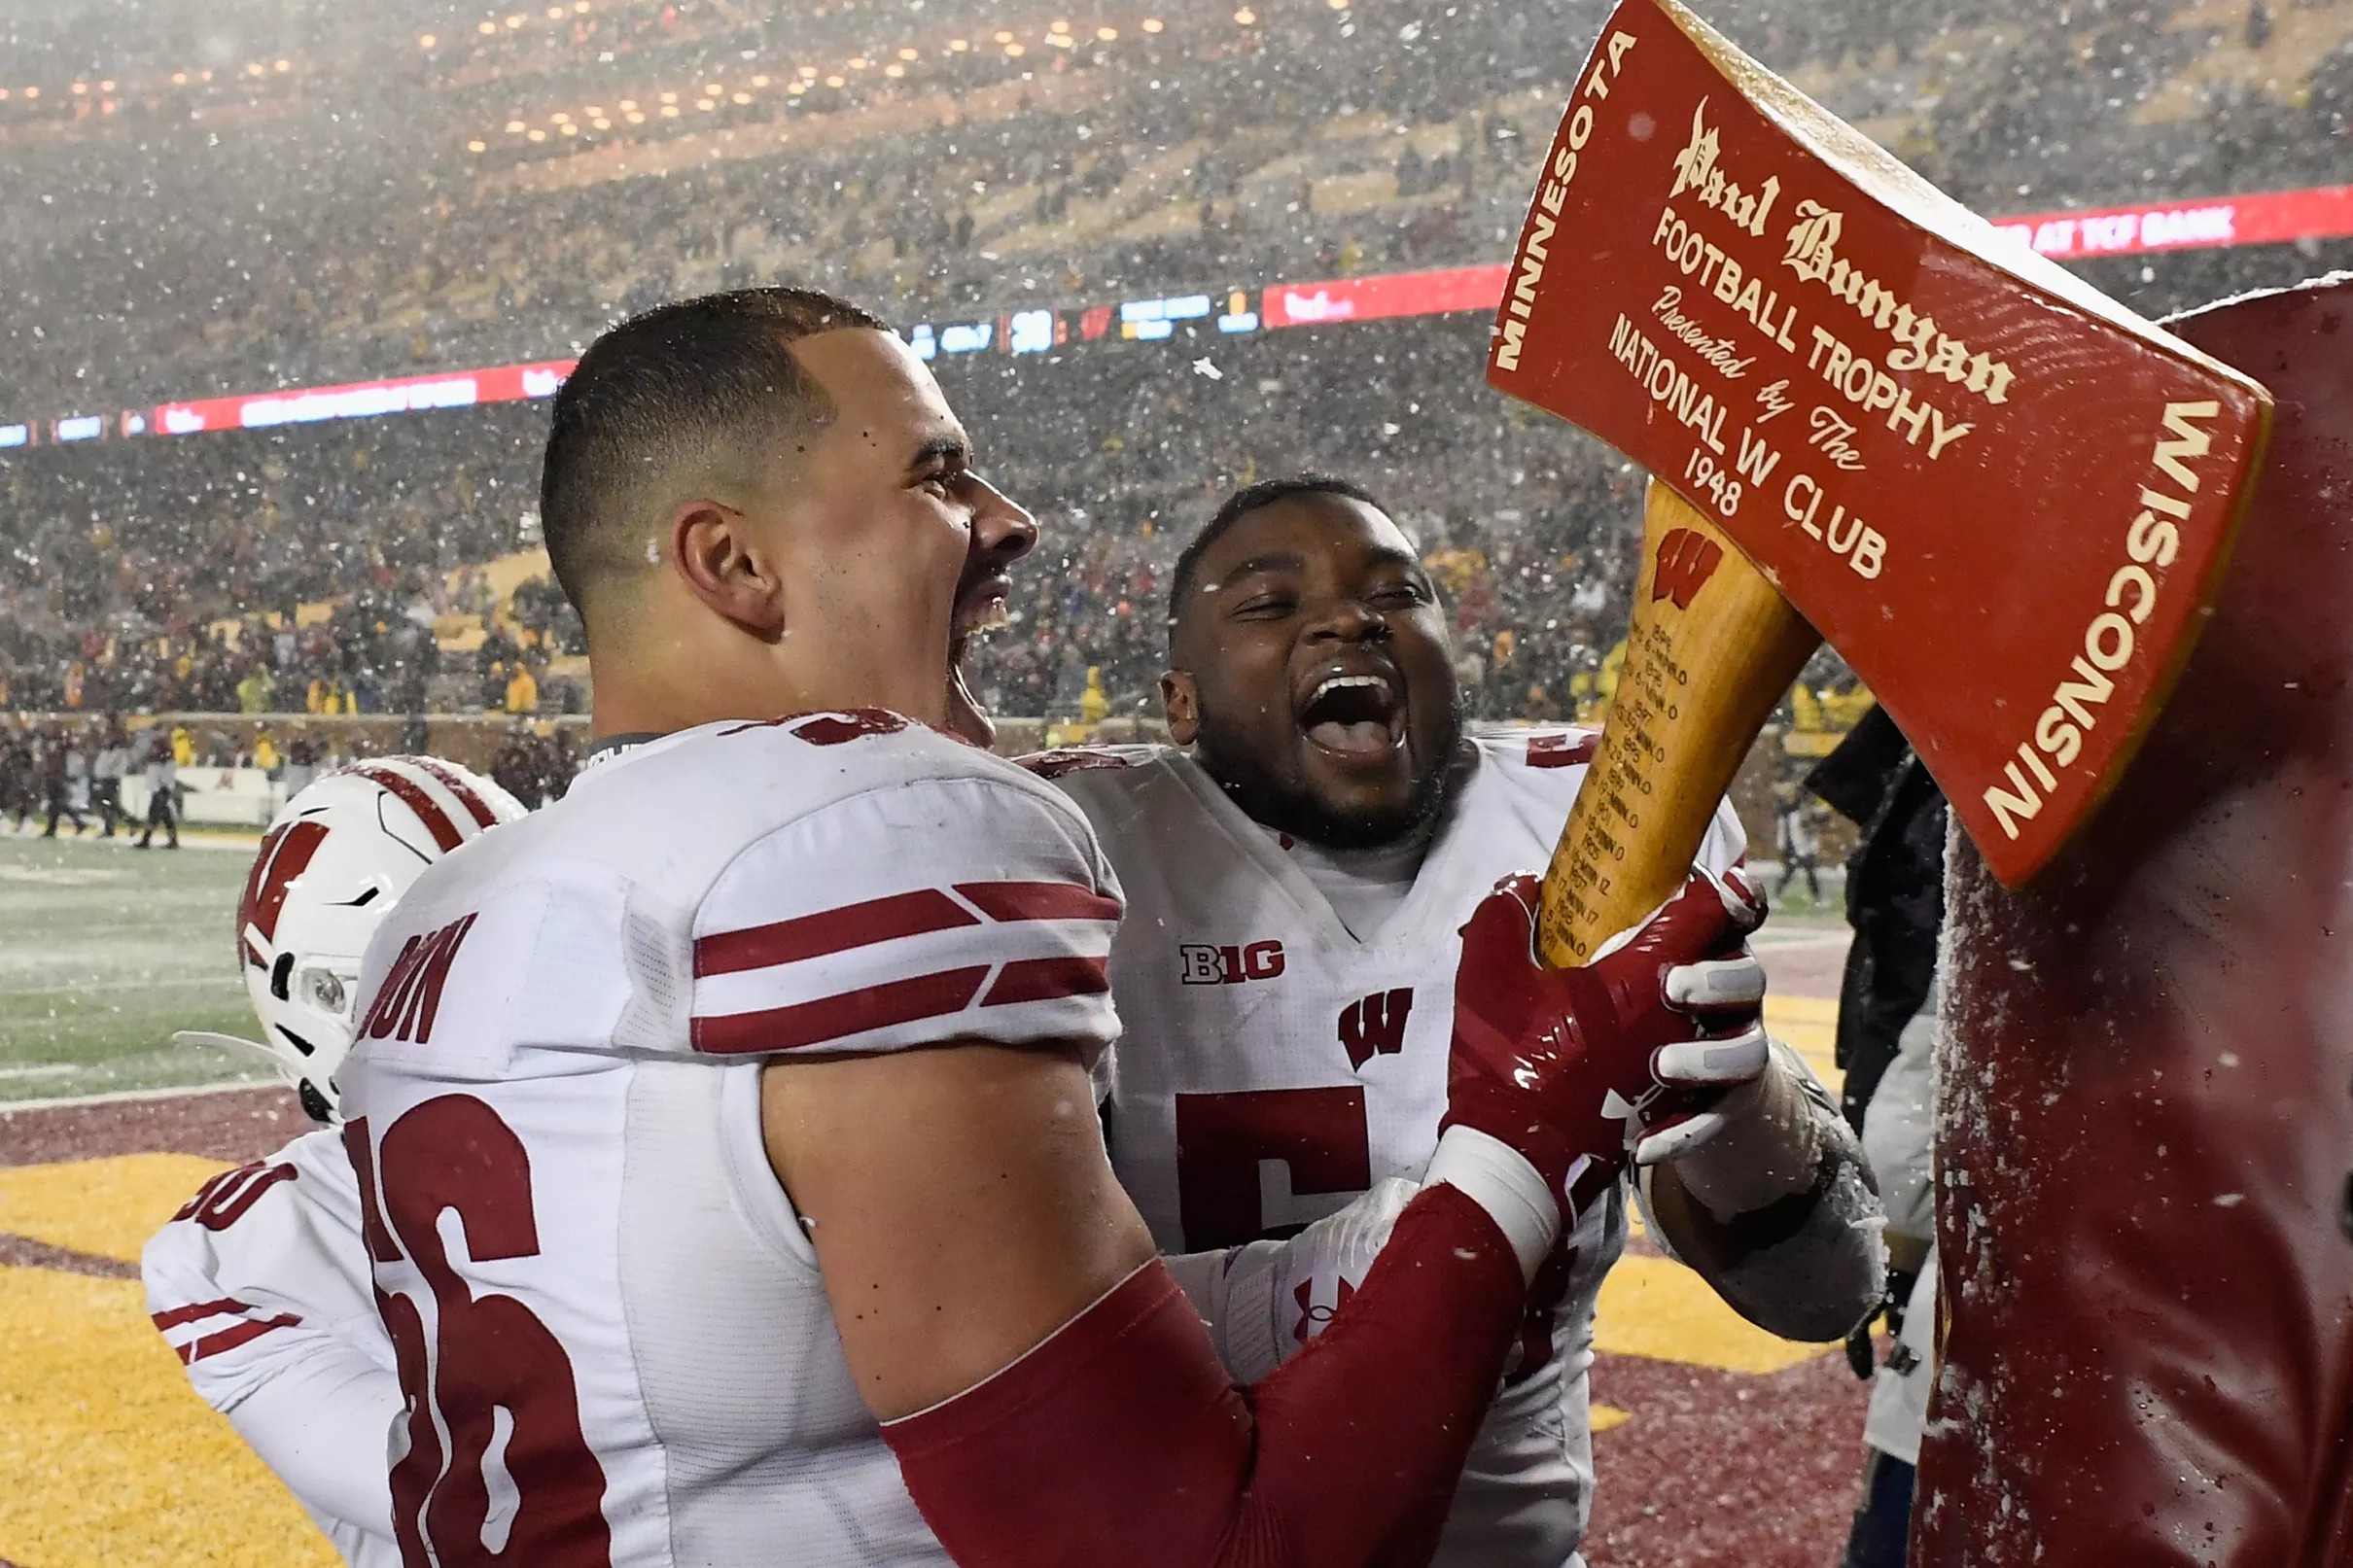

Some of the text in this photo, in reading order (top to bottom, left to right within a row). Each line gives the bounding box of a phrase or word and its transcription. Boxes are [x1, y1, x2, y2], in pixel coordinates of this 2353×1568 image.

[1495, 30, 1637, 371] MINNESOTA
[1668, 94, 2016, 404] Paul Bunyan
[1607, 312, 1887, 580] NATIONAL W CLUB
[1651, 285, 1867, 470] Presented by The
[1652, 206, 1954, 460] FOOTBALL TROPHY
[1684, 447, 1742, 517] 1948
[1983, 400, 2221, 841] WISCONSIN
[1338, 987, 1415, 1074] W
